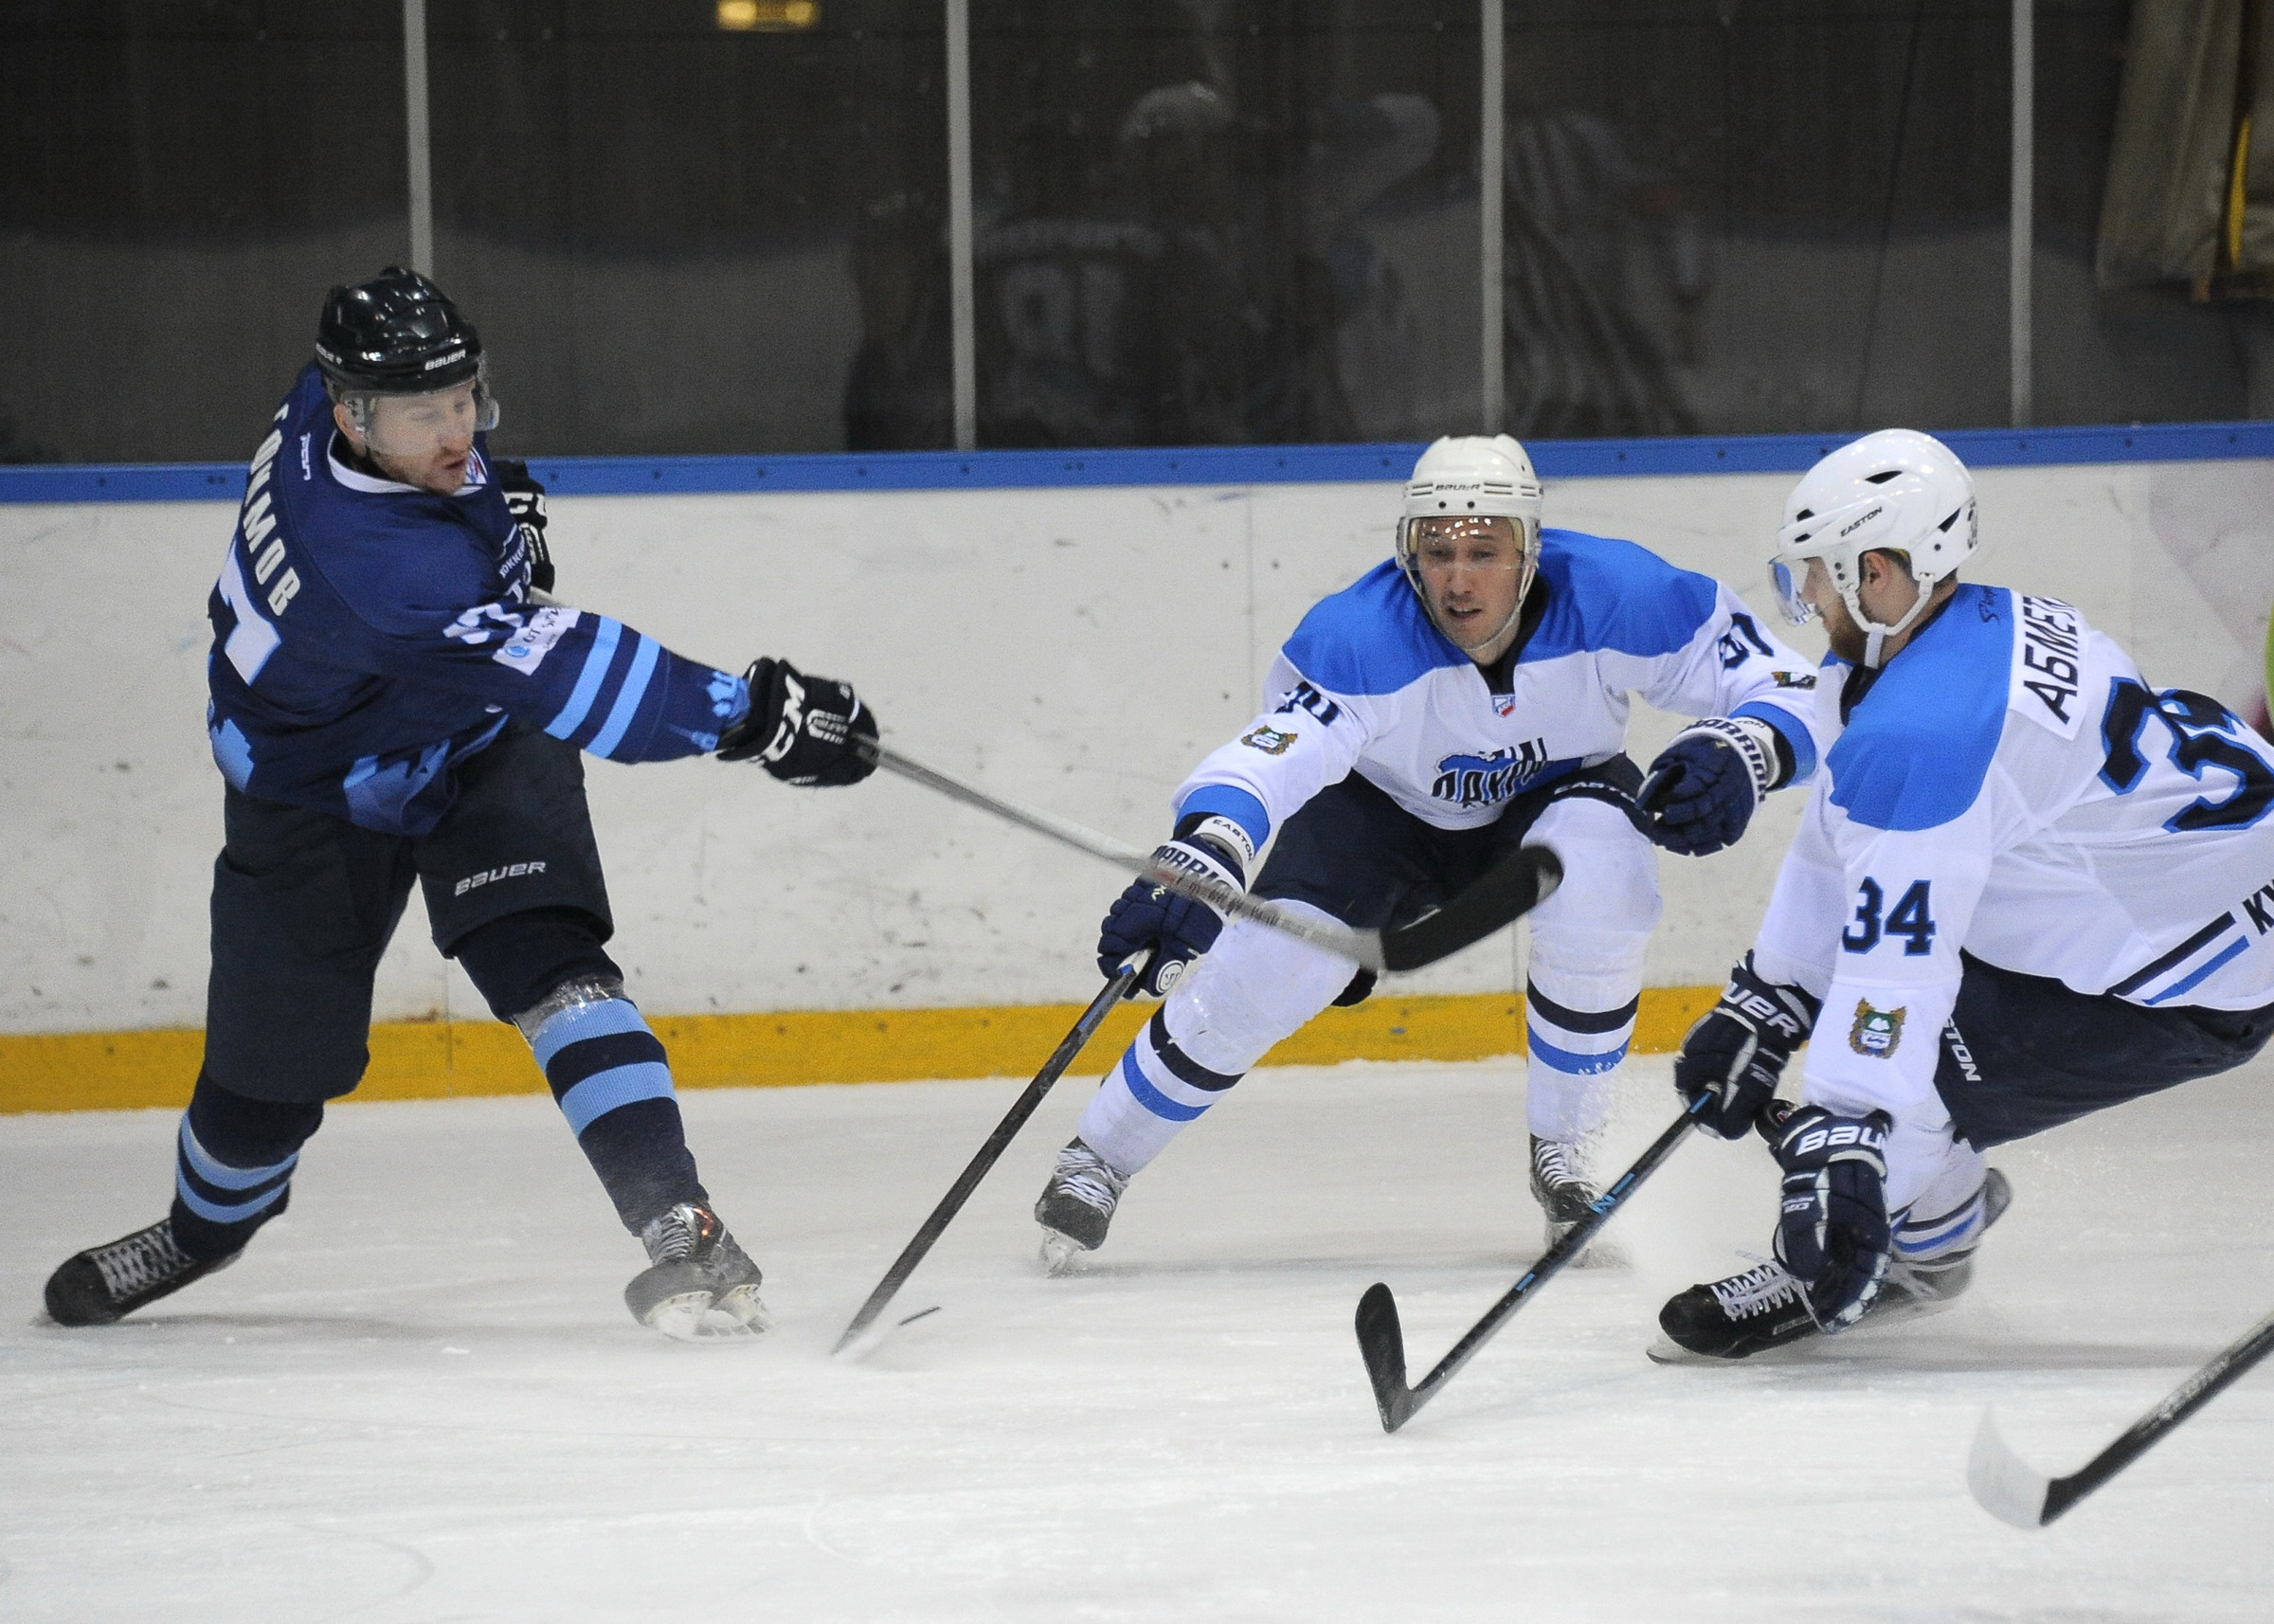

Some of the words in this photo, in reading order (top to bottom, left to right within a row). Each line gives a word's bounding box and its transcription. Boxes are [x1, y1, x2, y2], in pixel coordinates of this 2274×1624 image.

[242, 403, 301, 617] ФИМОВ
[1839, 506, 1884, 537] EASTON
[758, 674, 805, 765] CM
[1212, 818, 1254, 862] EASTON
[454, 860, 547, 897] BAUER
[1842, 875, 1936, 957] 34
